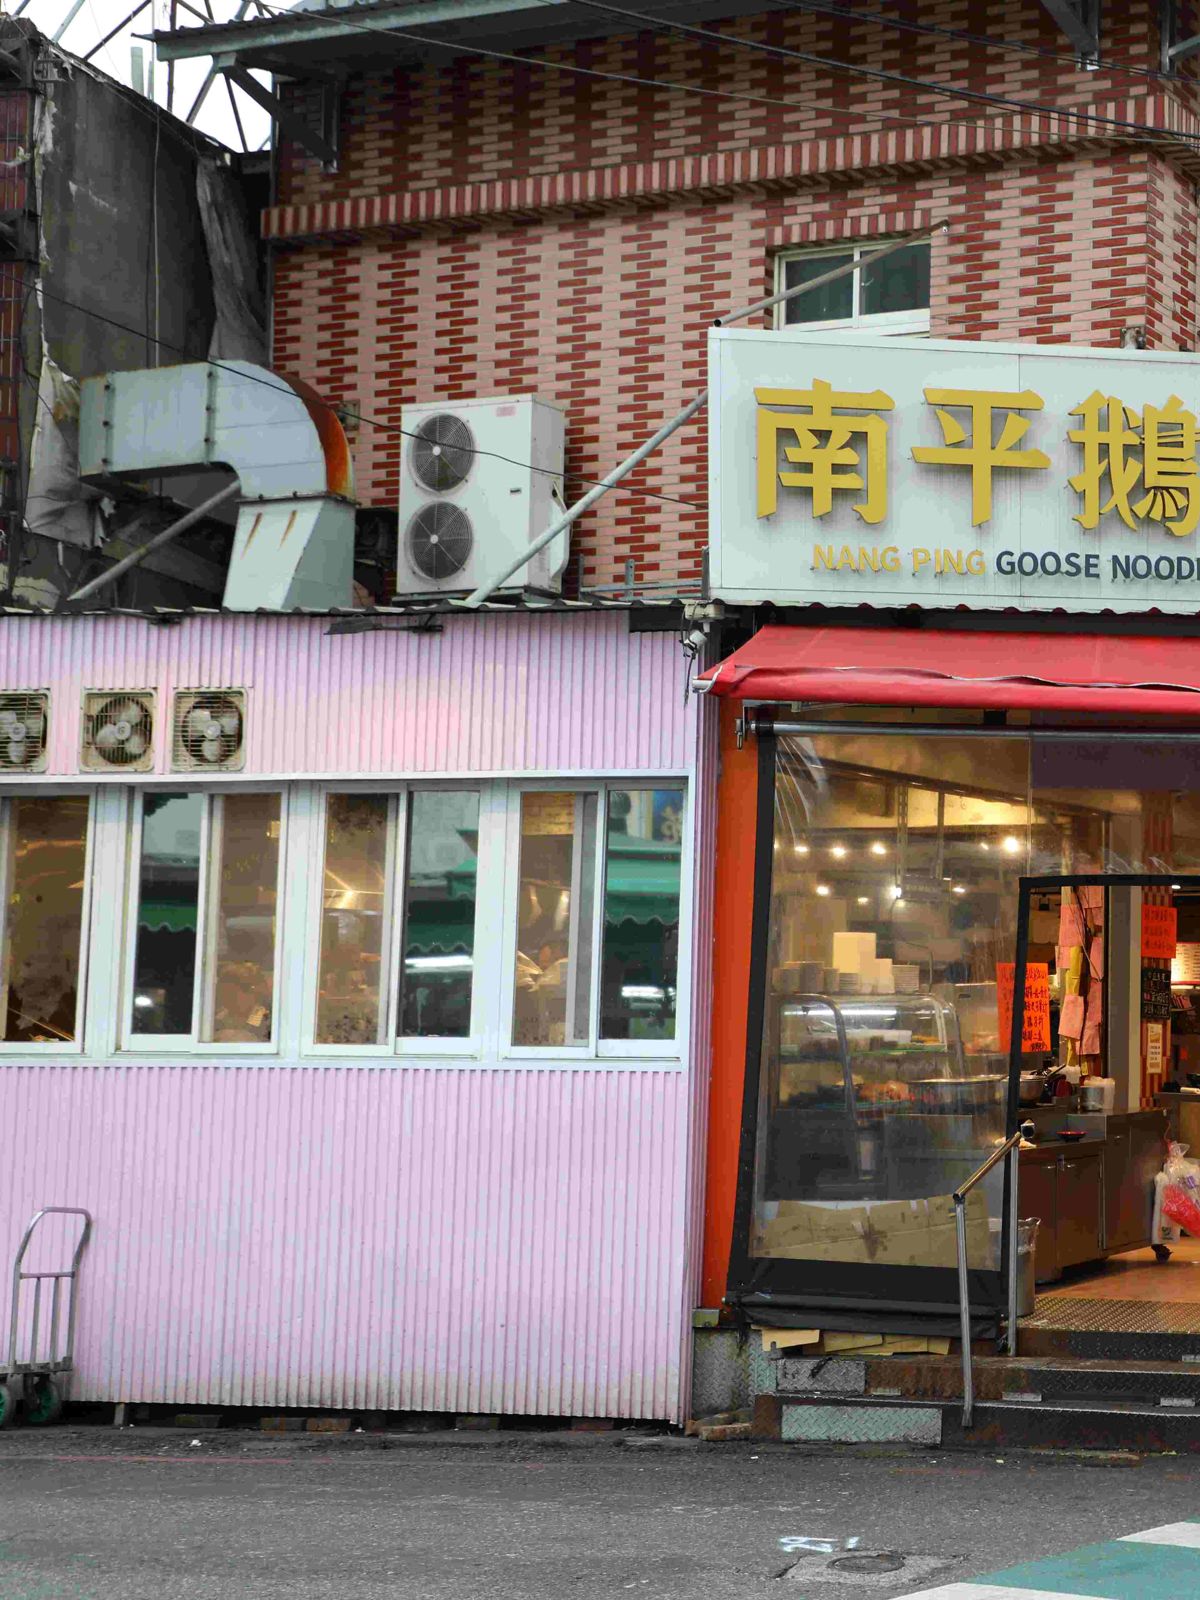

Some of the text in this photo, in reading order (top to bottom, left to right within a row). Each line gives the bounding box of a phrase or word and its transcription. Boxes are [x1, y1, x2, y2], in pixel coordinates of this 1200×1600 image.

[812, 543, 901, 574] NANG
[911, 546, 987, 577] PING
[995, 549, 1100, 579] GOOSE
